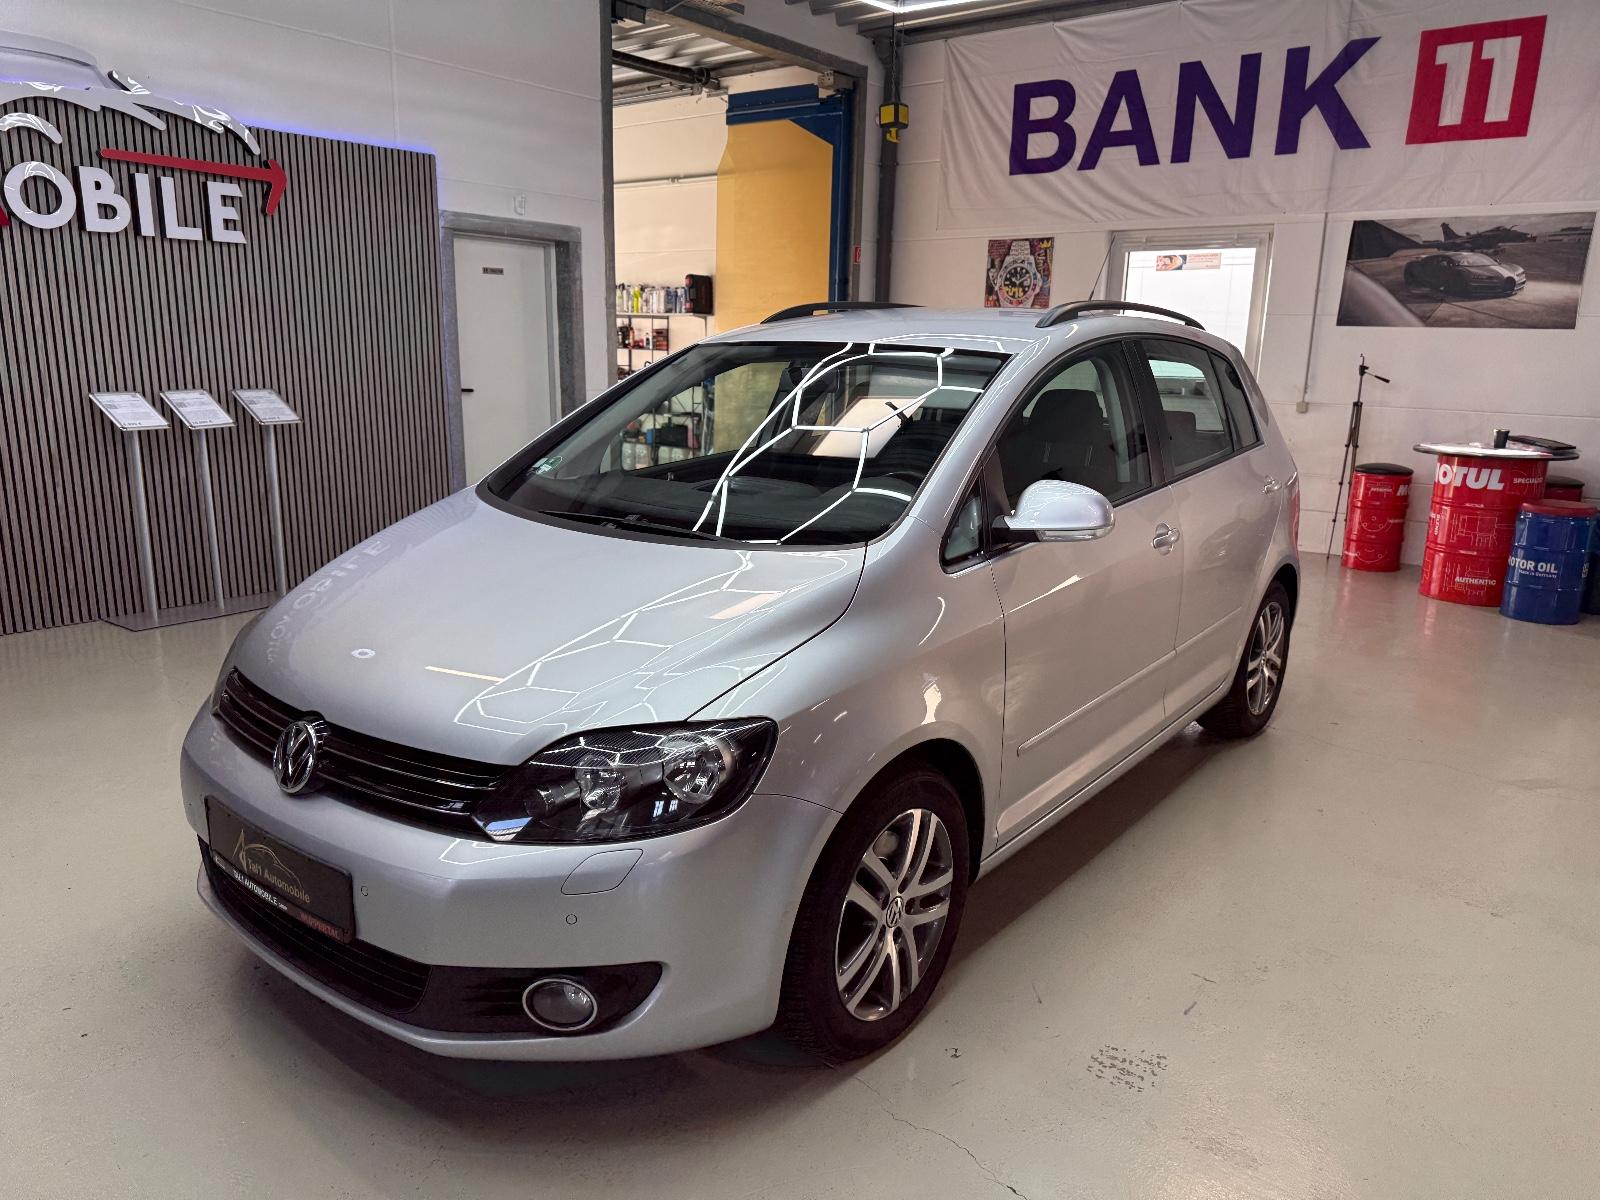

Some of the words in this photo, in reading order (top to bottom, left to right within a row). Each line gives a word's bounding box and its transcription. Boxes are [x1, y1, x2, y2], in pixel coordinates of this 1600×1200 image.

[1009, 36, 1381, 176] BANK
[1434, 35, 1523, 127] 11
[1538, 562, 1558, 573] OIL
[1455, 576, 1496, 586] AUTHENTIC
[263, 868, 311, 903] Automobile
